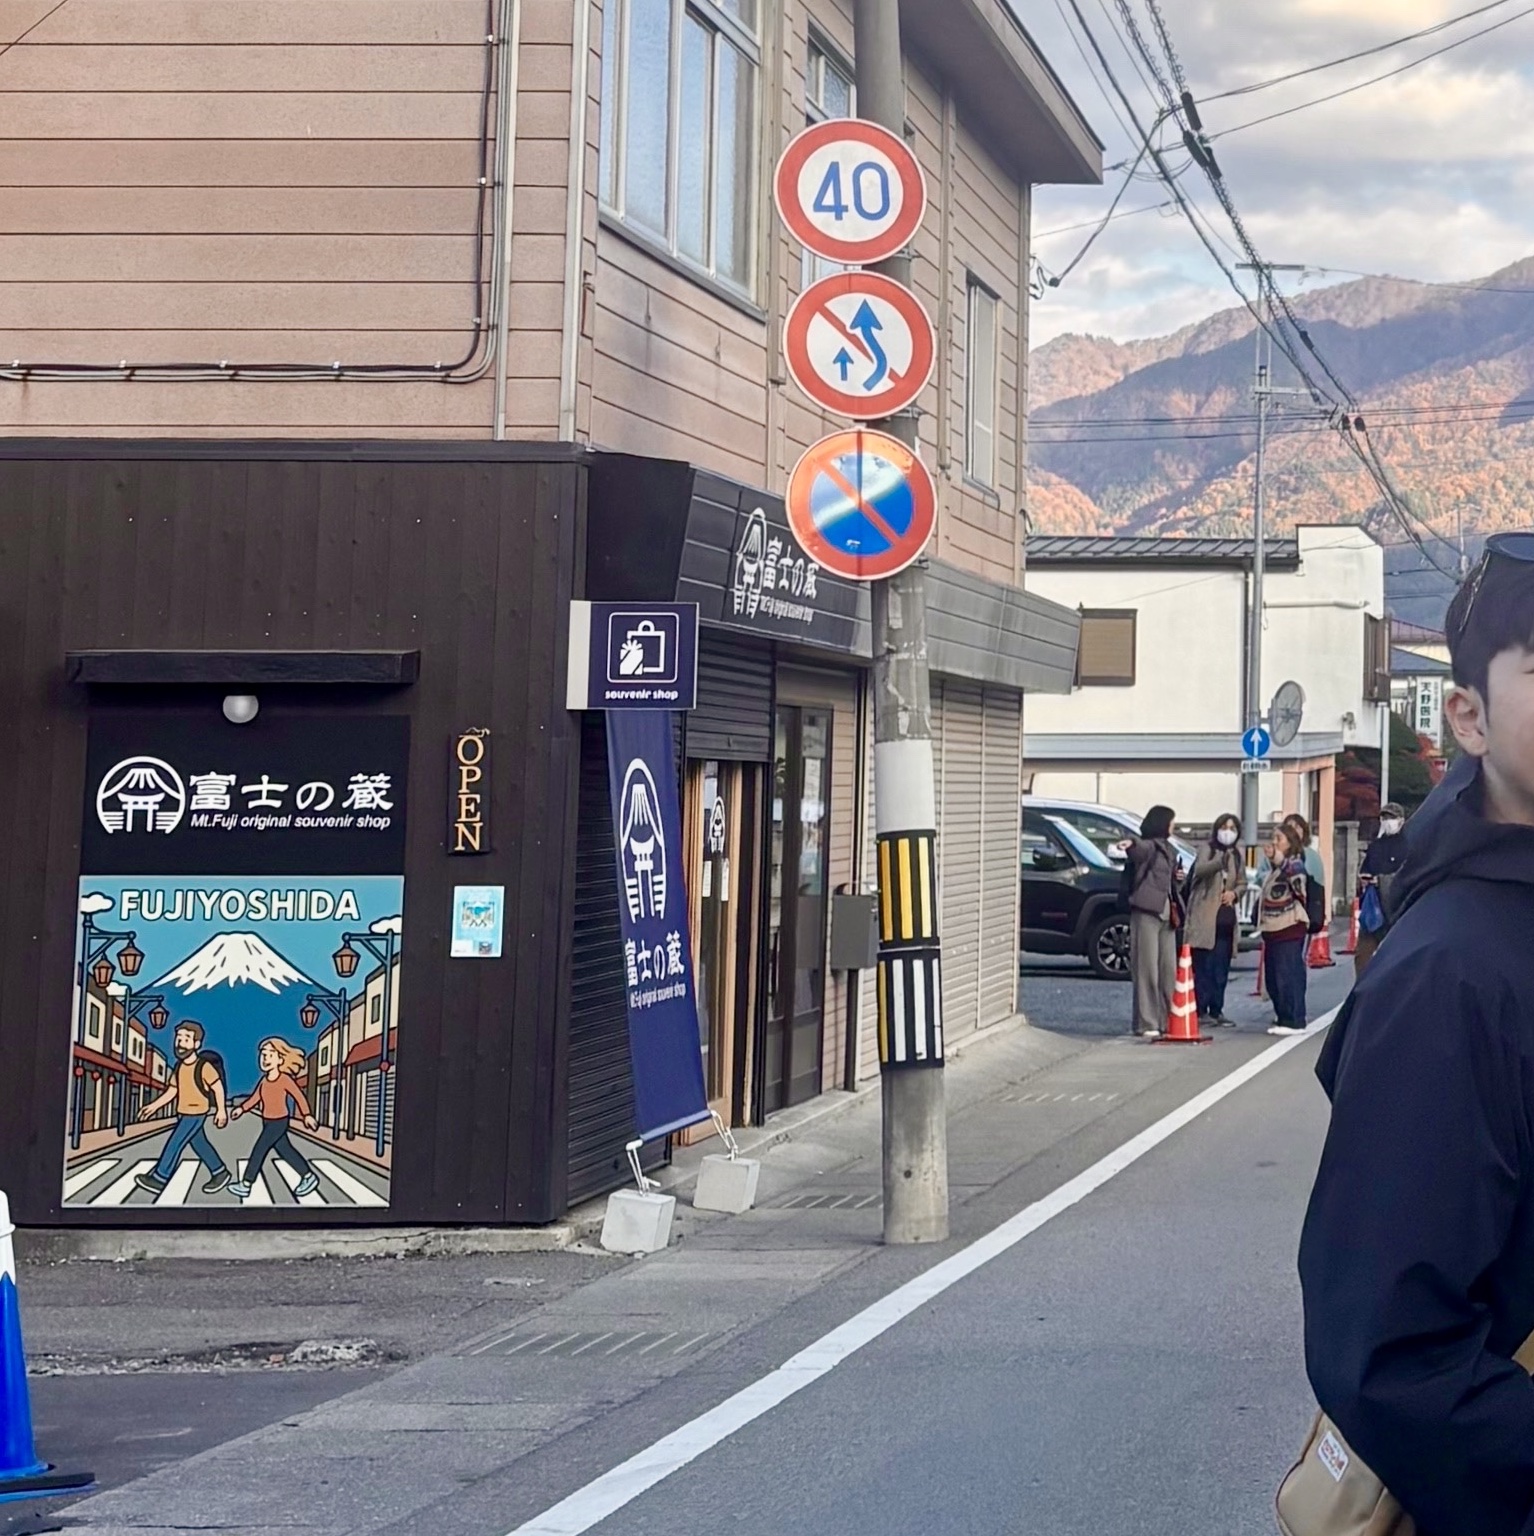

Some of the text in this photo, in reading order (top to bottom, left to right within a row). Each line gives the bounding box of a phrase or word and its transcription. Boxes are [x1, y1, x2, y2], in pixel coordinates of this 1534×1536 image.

[813, 161, 890, 220] 40
[604, 689, 678, 701] souvenir shop
[189, 770, 395, 812] 富士の蔵
[454, 735, 485, 851] OPEN
[190, 813, 391, 831] Mt.Fuji original souvenir shop
[119, 889, 361, 921] FUJIYOSHIDA
[625, 930, 685, 987] 富士の蔵
